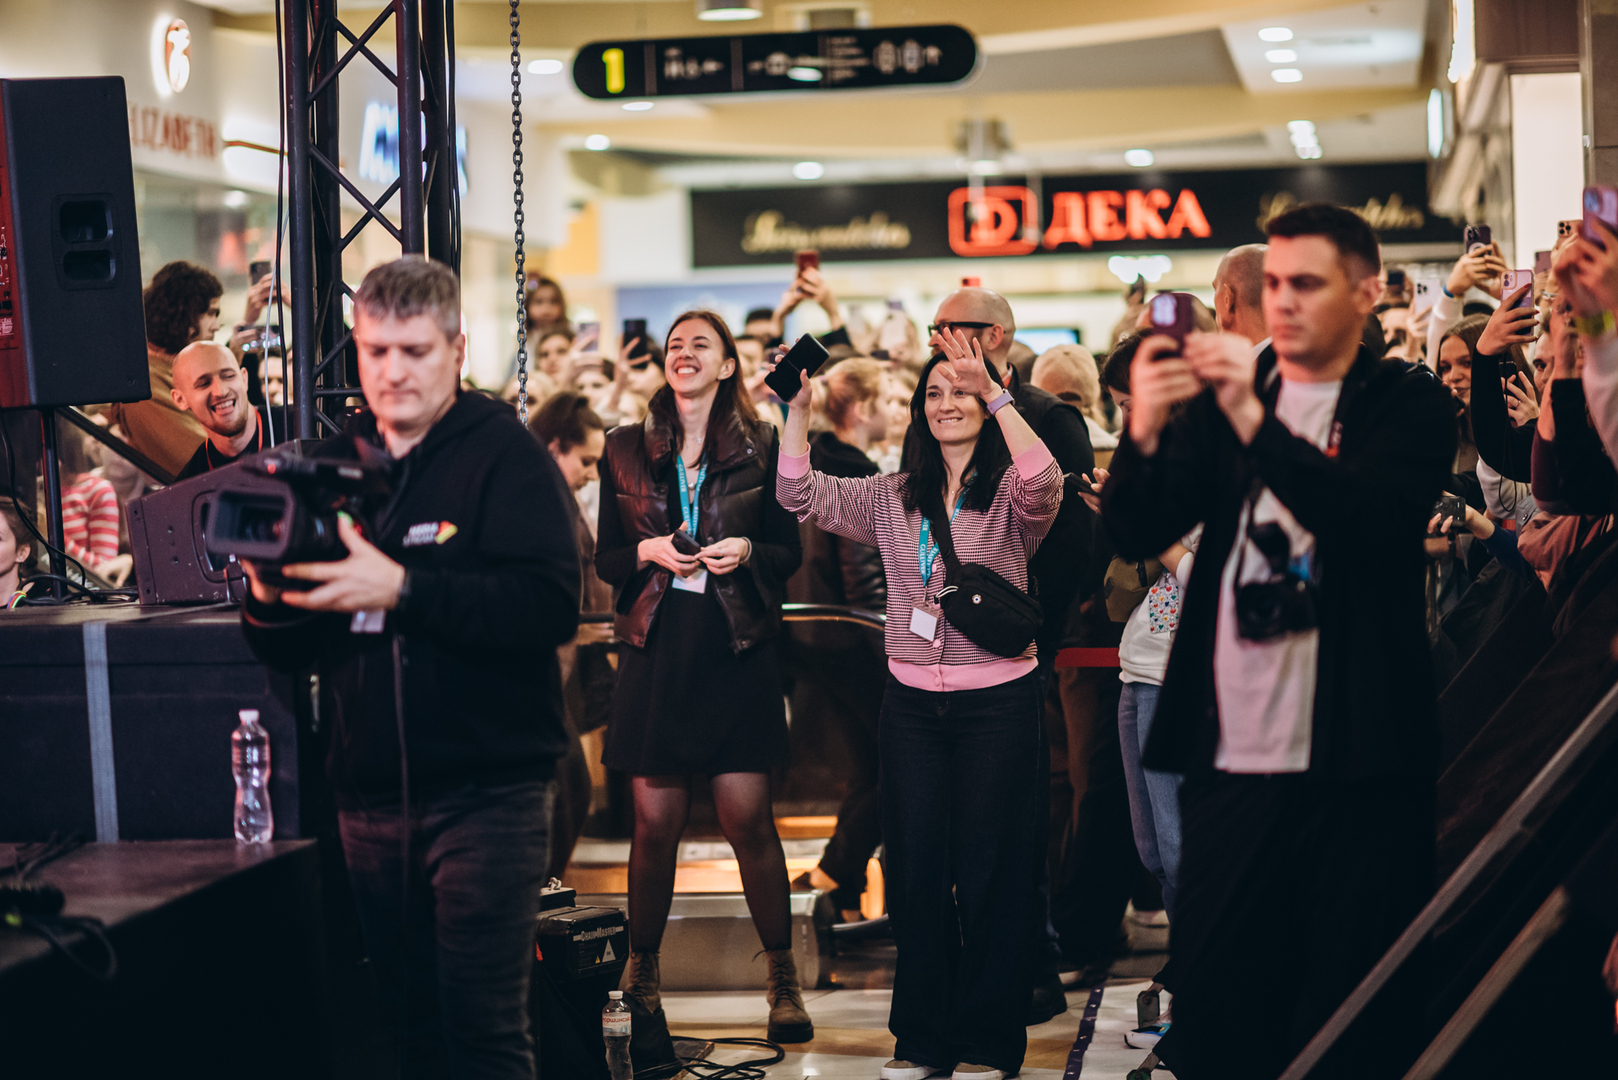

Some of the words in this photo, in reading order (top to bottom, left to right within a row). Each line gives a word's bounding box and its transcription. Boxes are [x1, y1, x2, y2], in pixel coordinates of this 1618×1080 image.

[601, 48, 626, 94] 1
[1042, 188, 1212, 250] ДЕКА
[679, 464, 687, 493] GULLIVER
